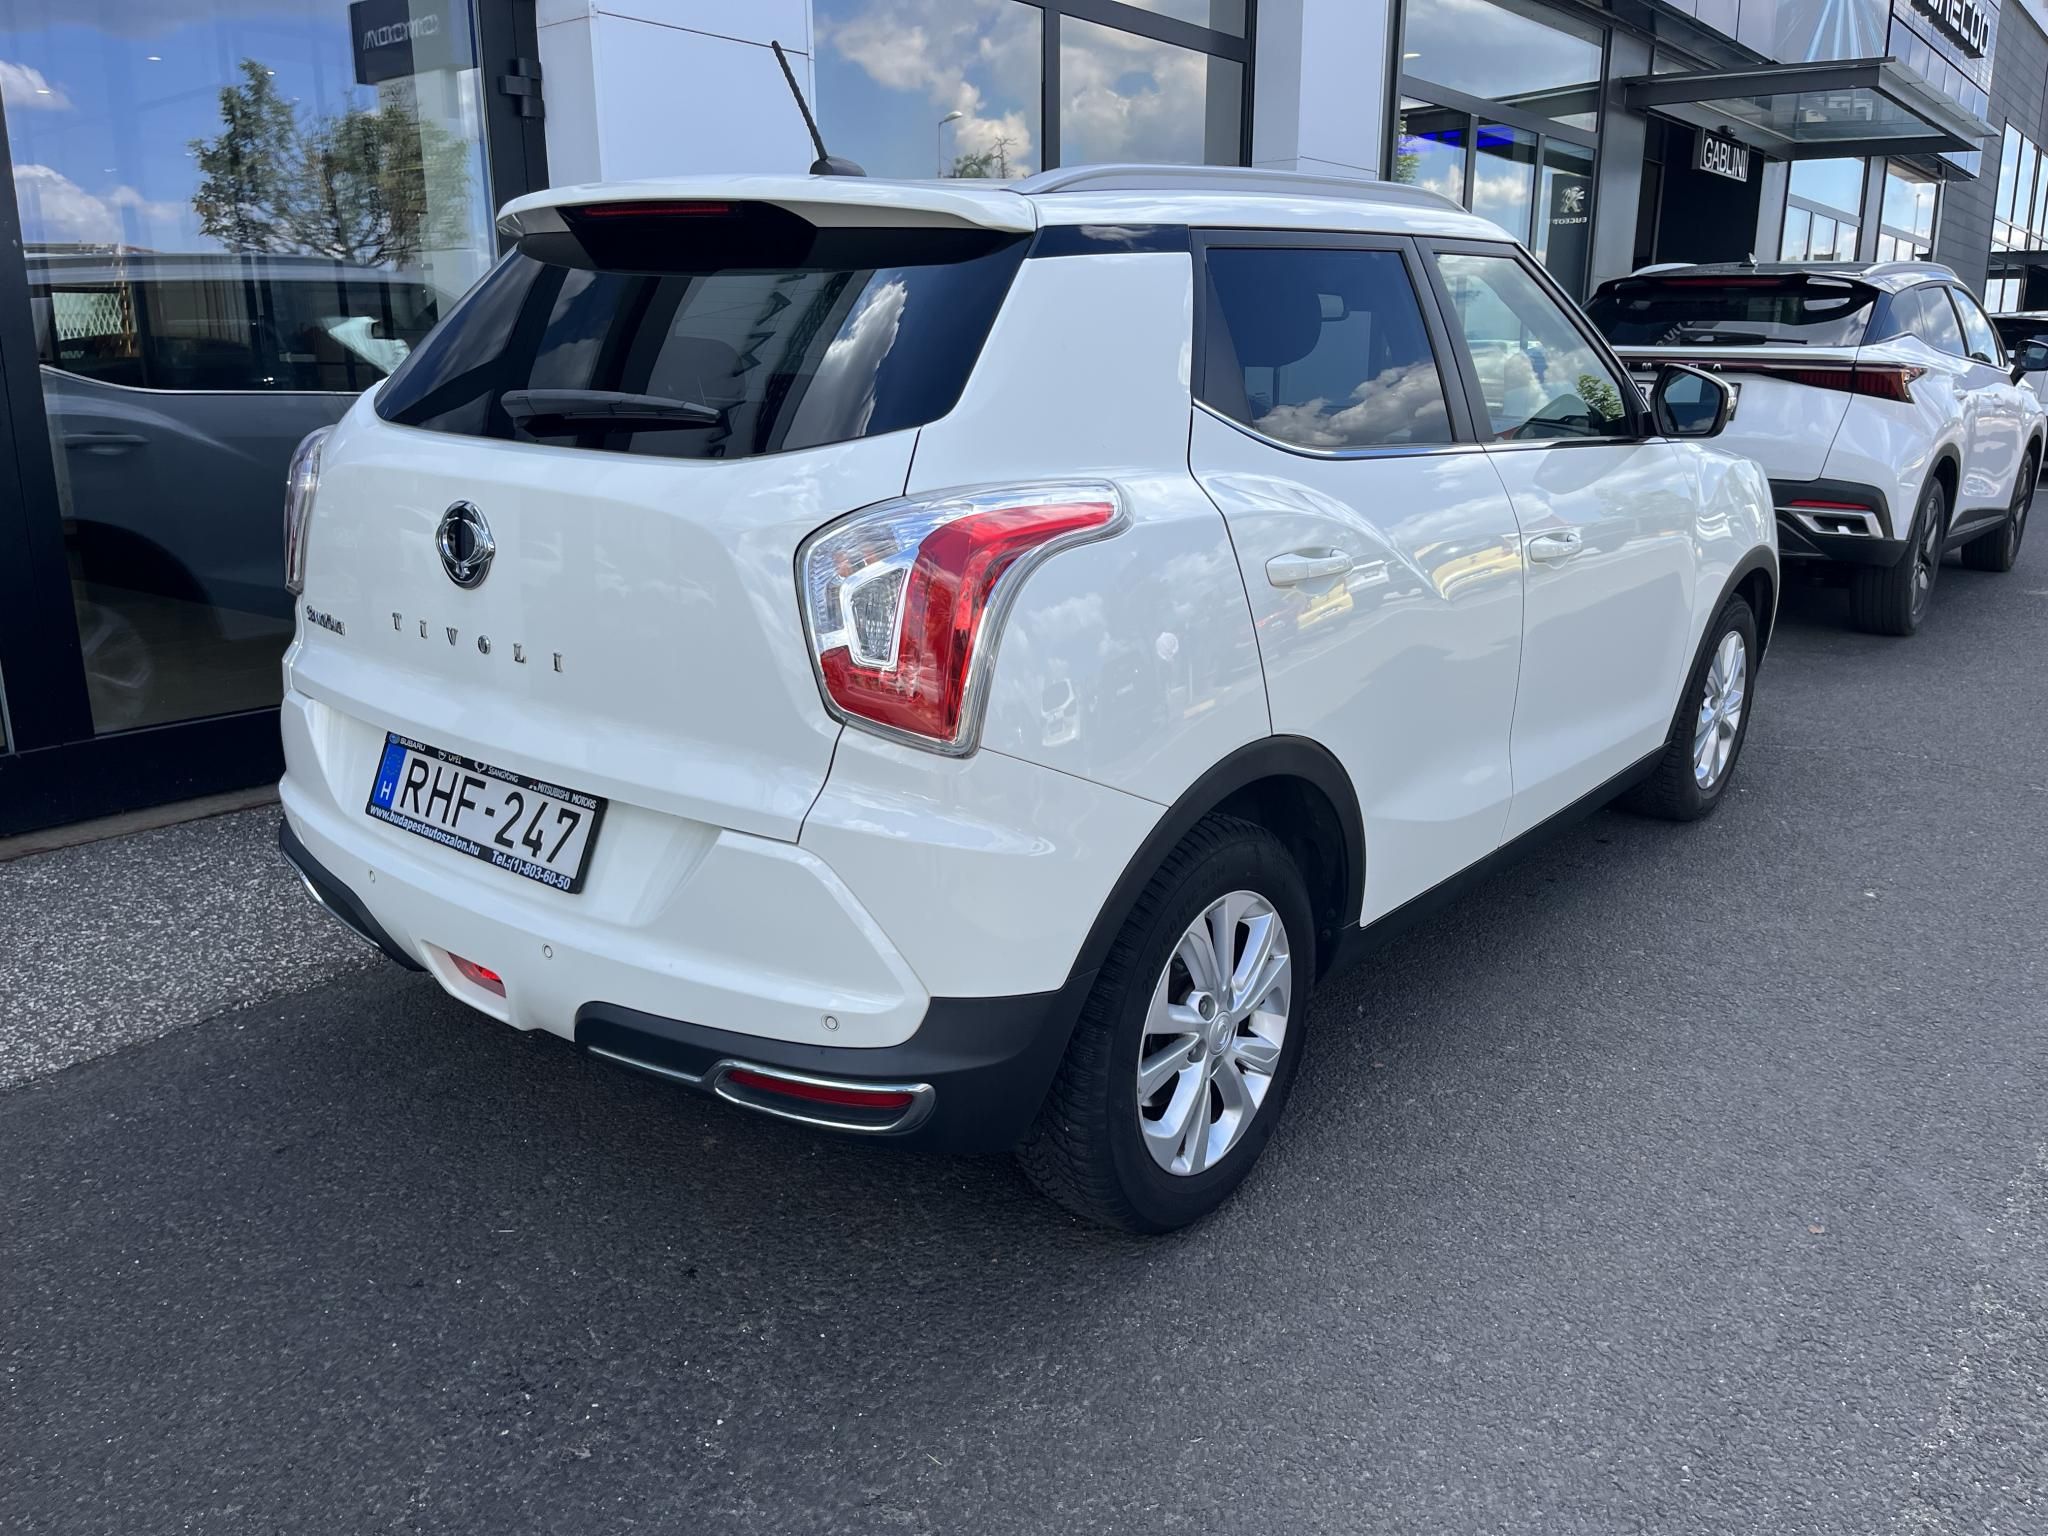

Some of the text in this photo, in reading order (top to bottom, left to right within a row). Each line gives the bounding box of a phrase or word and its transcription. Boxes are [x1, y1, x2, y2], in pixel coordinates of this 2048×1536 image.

[1703, 138, 1747, 178] GABLINI
[392, 612, 563, 673] TIVOLI
[400, 737, 426, 751] SUBARU
[380, 781, 392, 801] H
[400, 758, 581, 863] RHF-247
[537, 782, 597, 810] MITSUBISHI MOTORS
[370, 805, 481, 856] www.budapestautoszalon.hu
